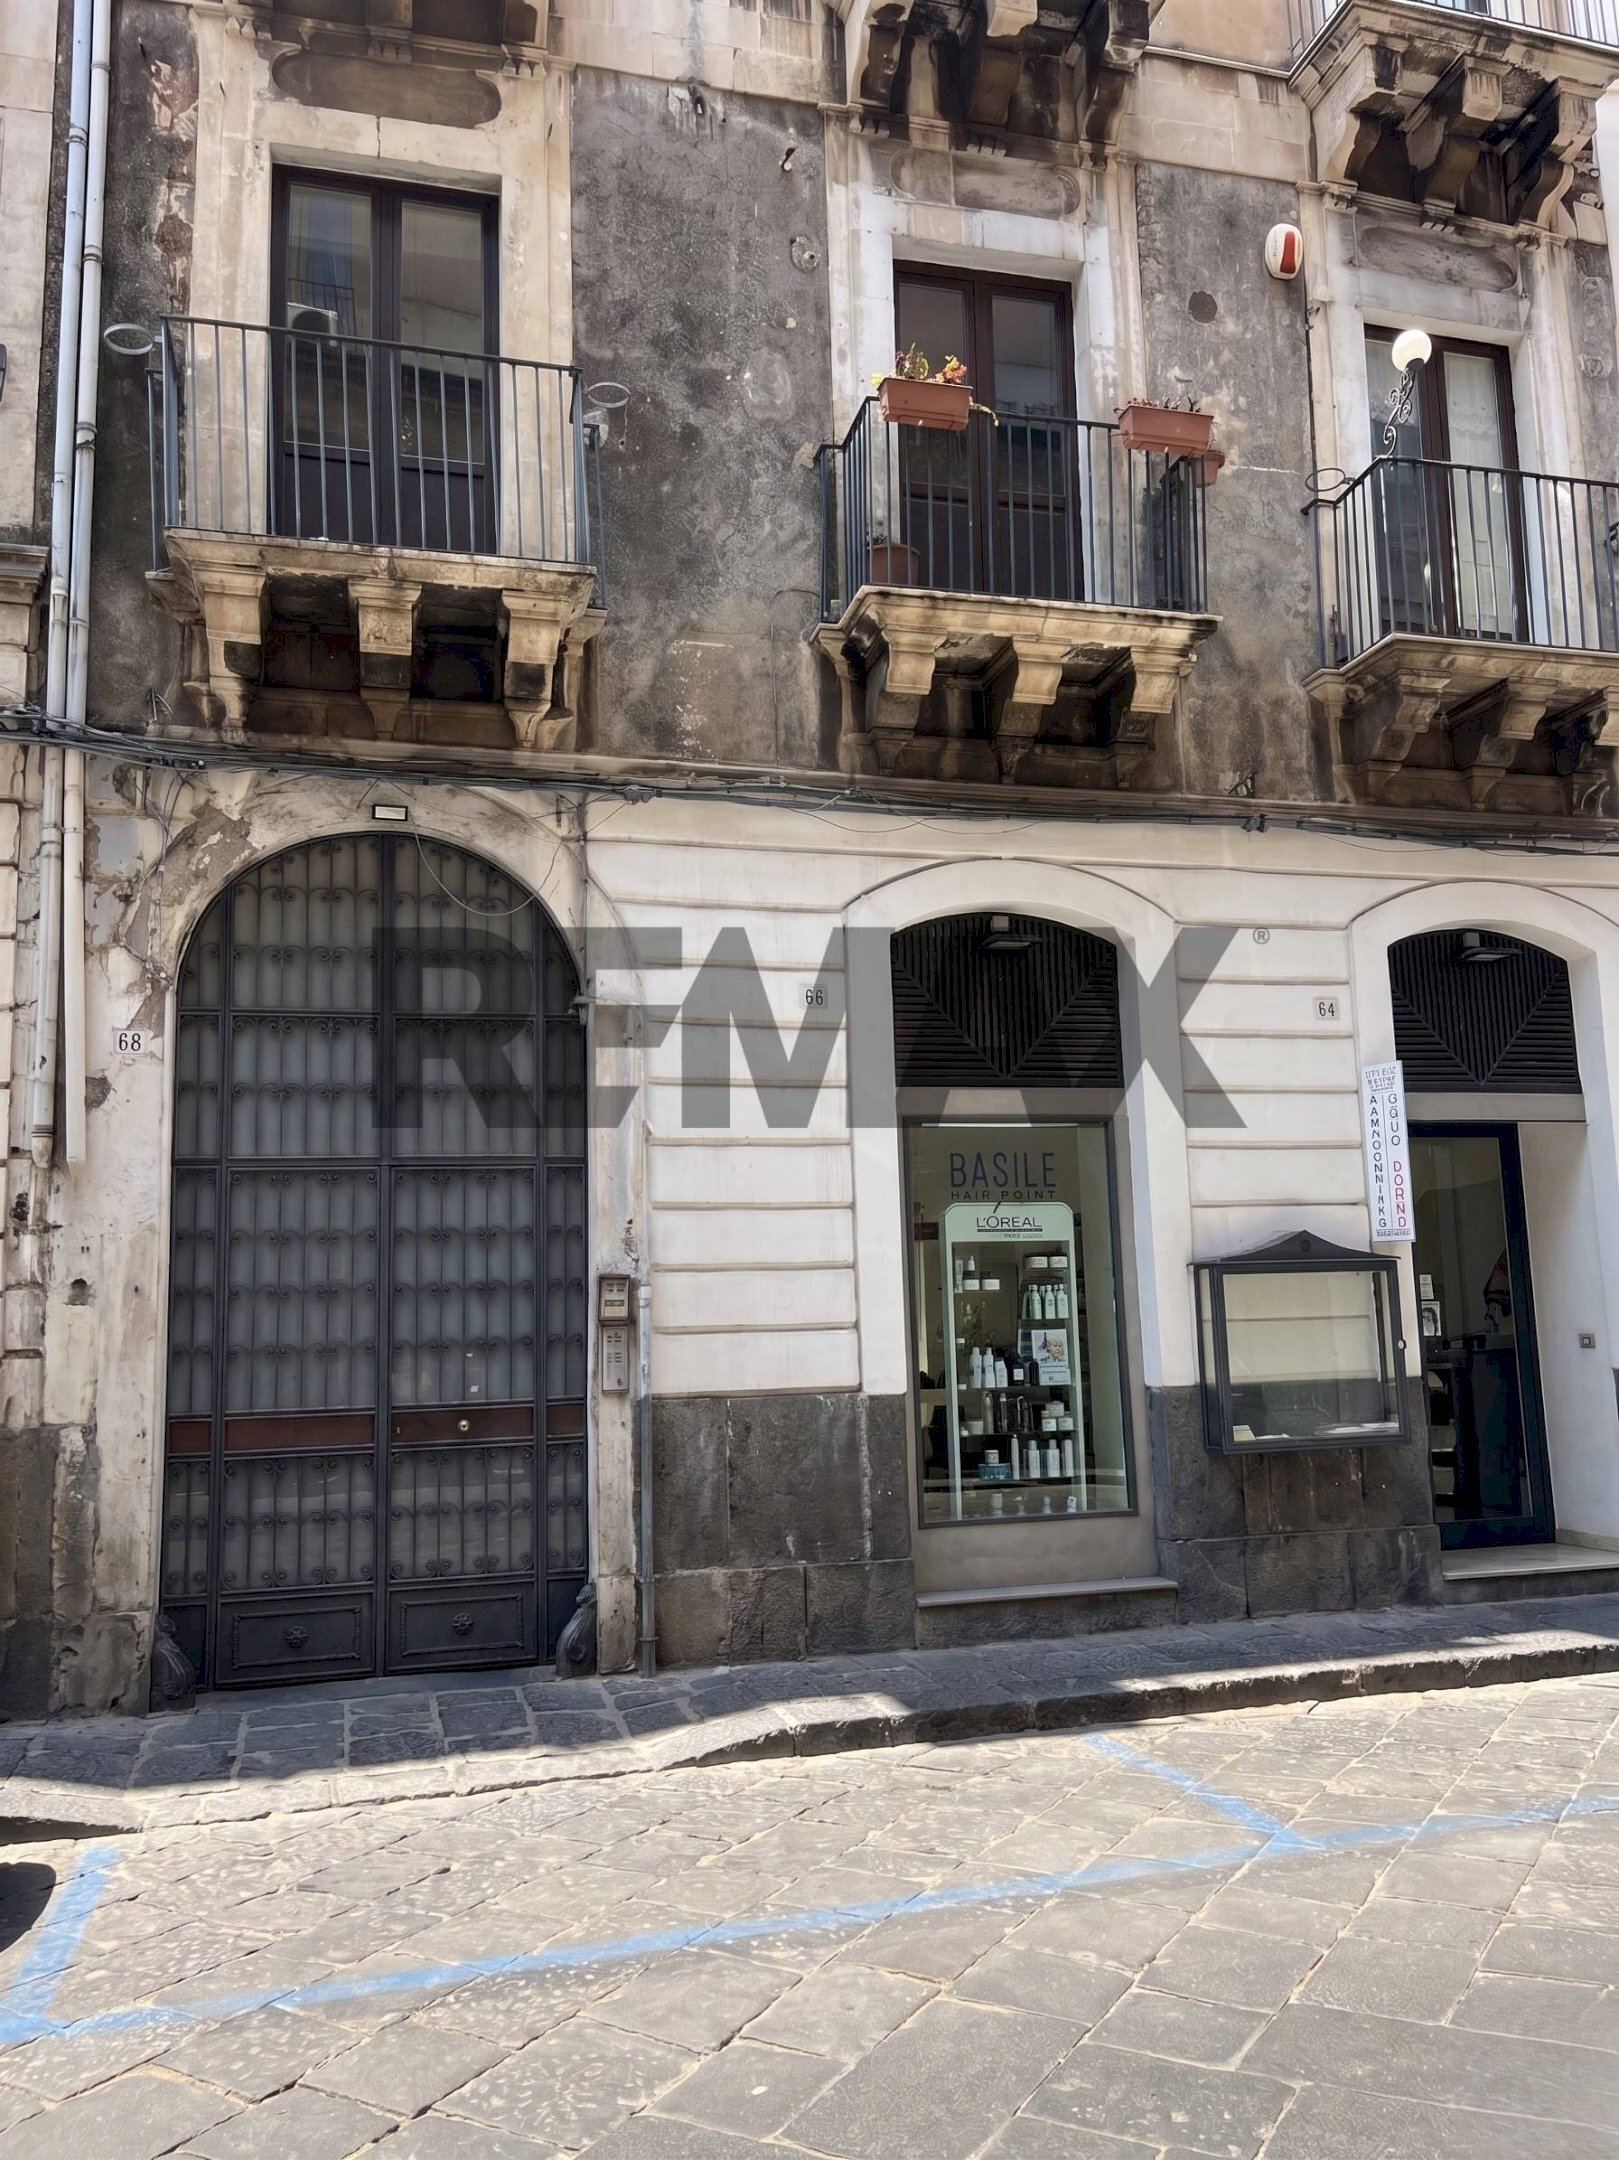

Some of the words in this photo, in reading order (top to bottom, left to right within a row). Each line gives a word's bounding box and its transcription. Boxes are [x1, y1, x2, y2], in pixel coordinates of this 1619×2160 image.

[805, 988, 823, 1006] 66
[1318, 1001, 1335, 1017] 64
[119, 1032, 141, 1051] 68
[949, 1152, 1056, 1188] BASILE
[951, 1190, 990, 1200] HAIR
[1001, 1190, 1056, 1200] POINT
